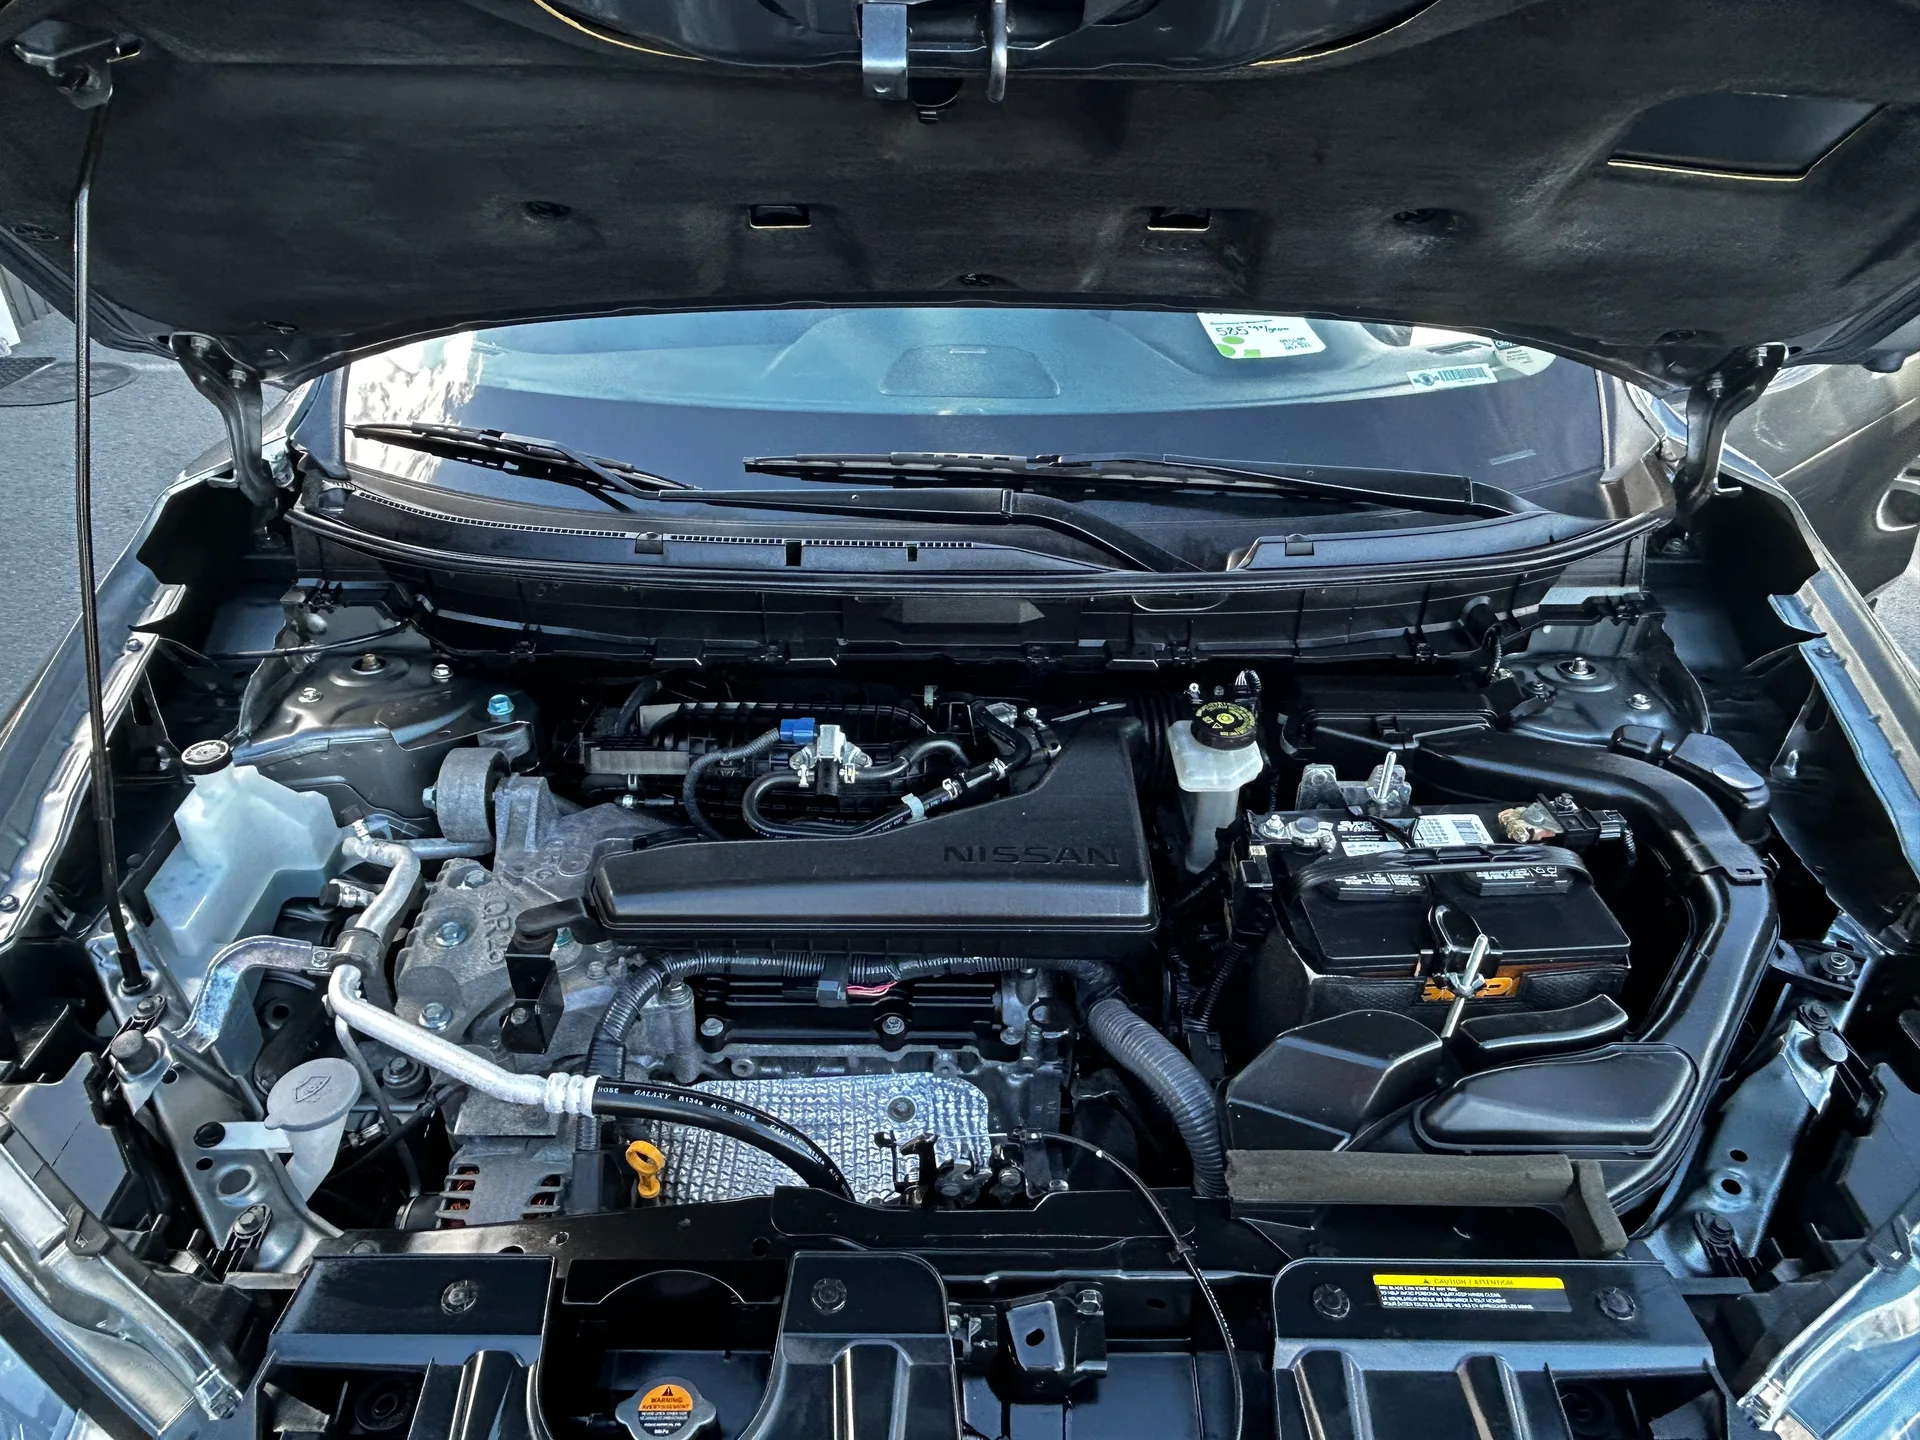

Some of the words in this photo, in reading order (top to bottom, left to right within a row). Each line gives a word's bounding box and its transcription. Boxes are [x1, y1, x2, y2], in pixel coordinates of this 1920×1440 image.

[943, 846, 1119, 867] NISSAN
[633, 1089, 671, 1100] GALAXY
[678, 1095, 704, 1106] R134a
[710, 1103, 728, 1112] A/C
[734, 1109, 756, 1122] HOSE
[769, 1124, 802, 1144] GALAXY
